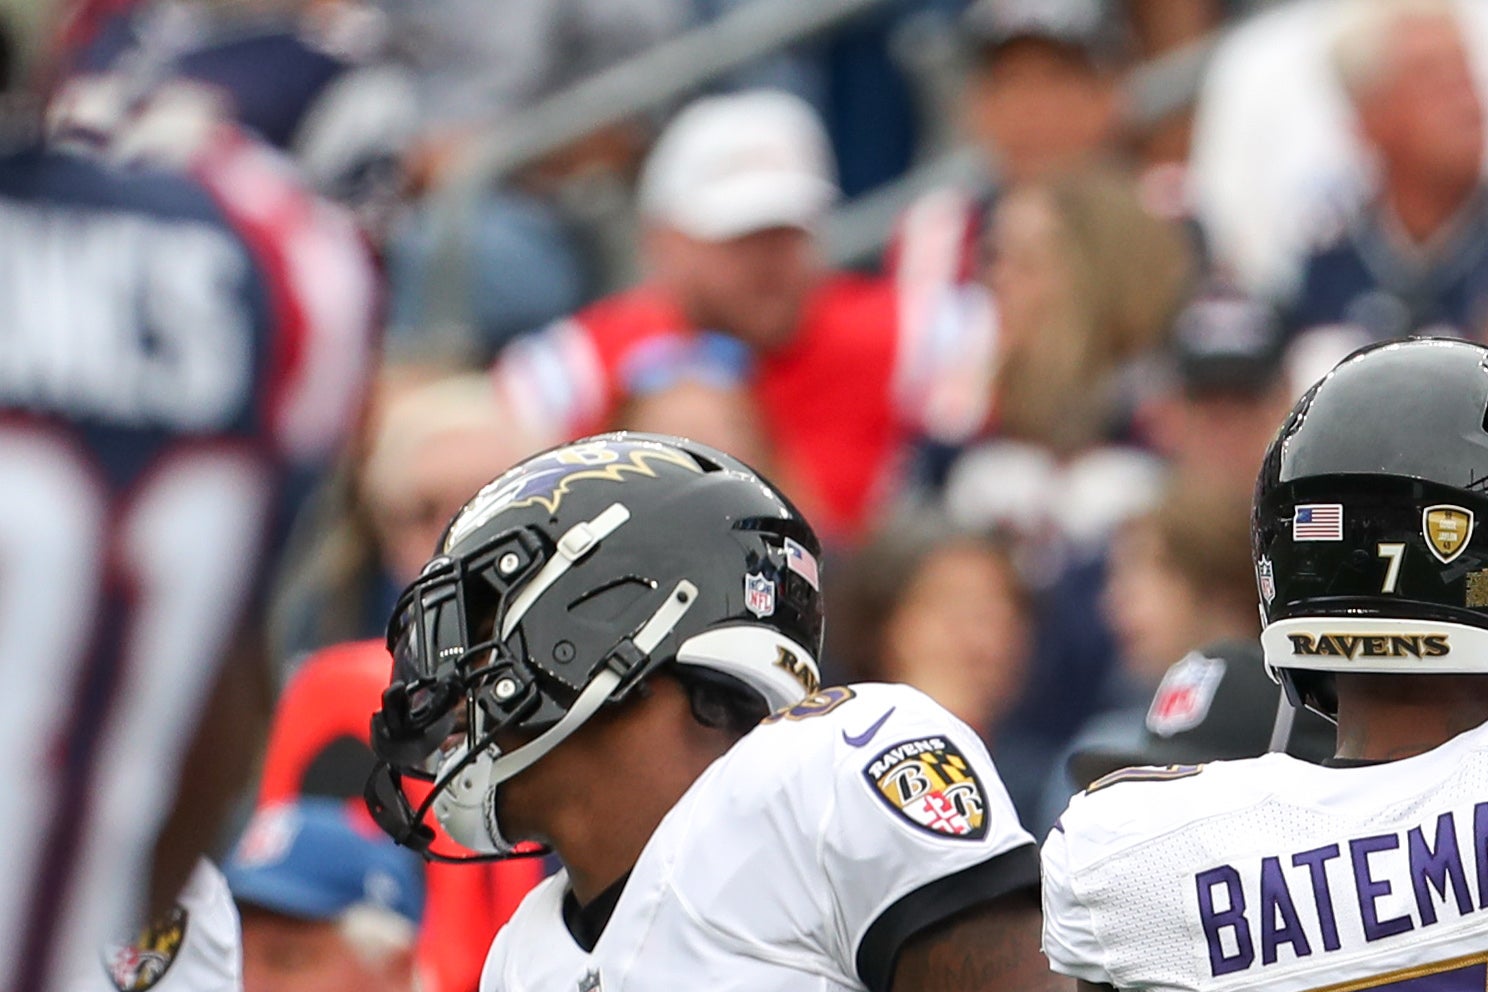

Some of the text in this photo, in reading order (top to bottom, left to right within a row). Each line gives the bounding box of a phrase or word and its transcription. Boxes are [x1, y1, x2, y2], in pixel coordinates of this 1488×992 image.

[1377, 542, 1407, 594] 7
[749, 591, 773, 612] NFL
[1287, 632, 1452, 662] RAVENS
[868, 737, 946, 781] RAVENS
[881, 759, 932, 807] B
